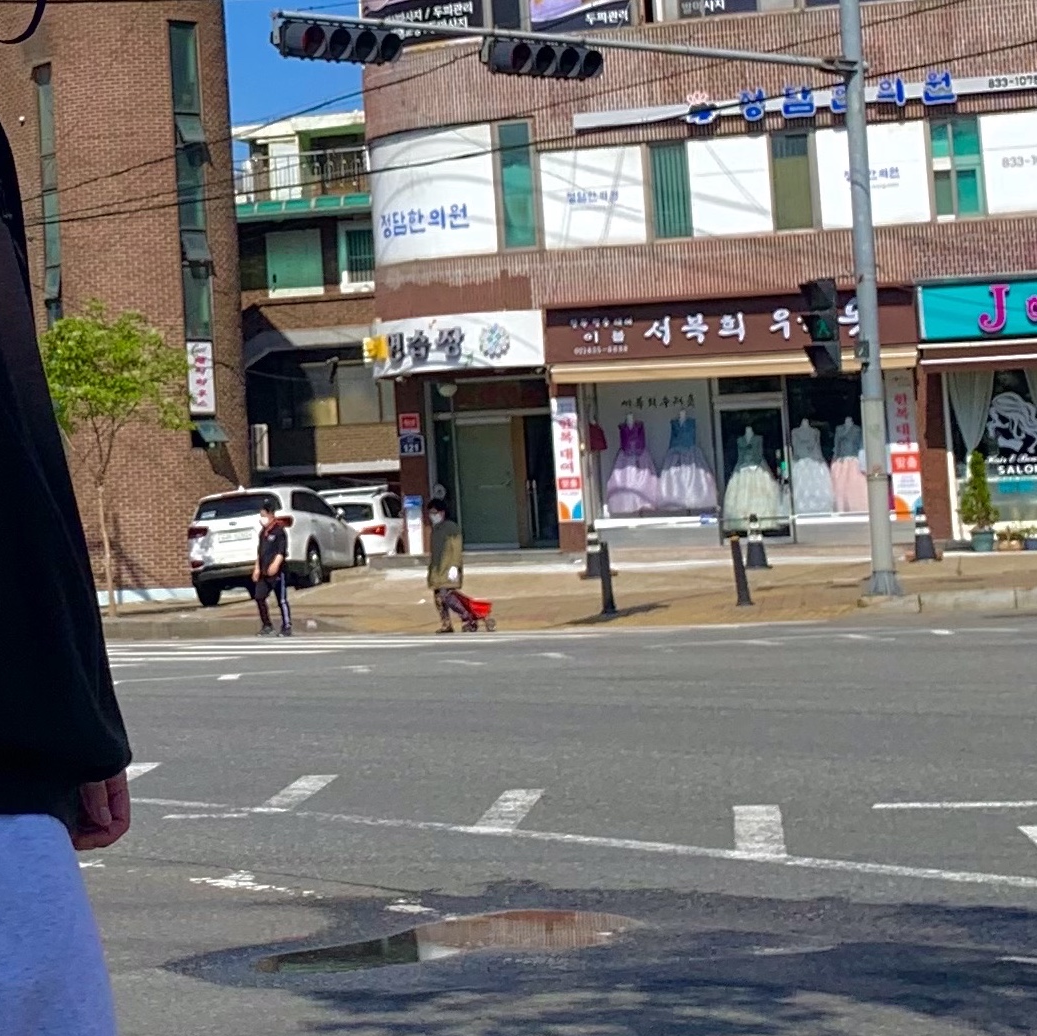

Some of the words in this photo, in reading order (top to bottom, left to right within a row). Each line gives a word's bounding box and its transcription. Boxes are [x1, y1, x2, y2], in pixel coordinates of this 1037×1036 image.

[1001, 154, 1037, 169] 833-1
[380, 203, 470, 239] 정담한의원
[644, 312, 746, 346] 서복희
[403, 443, 419, 453] 121
